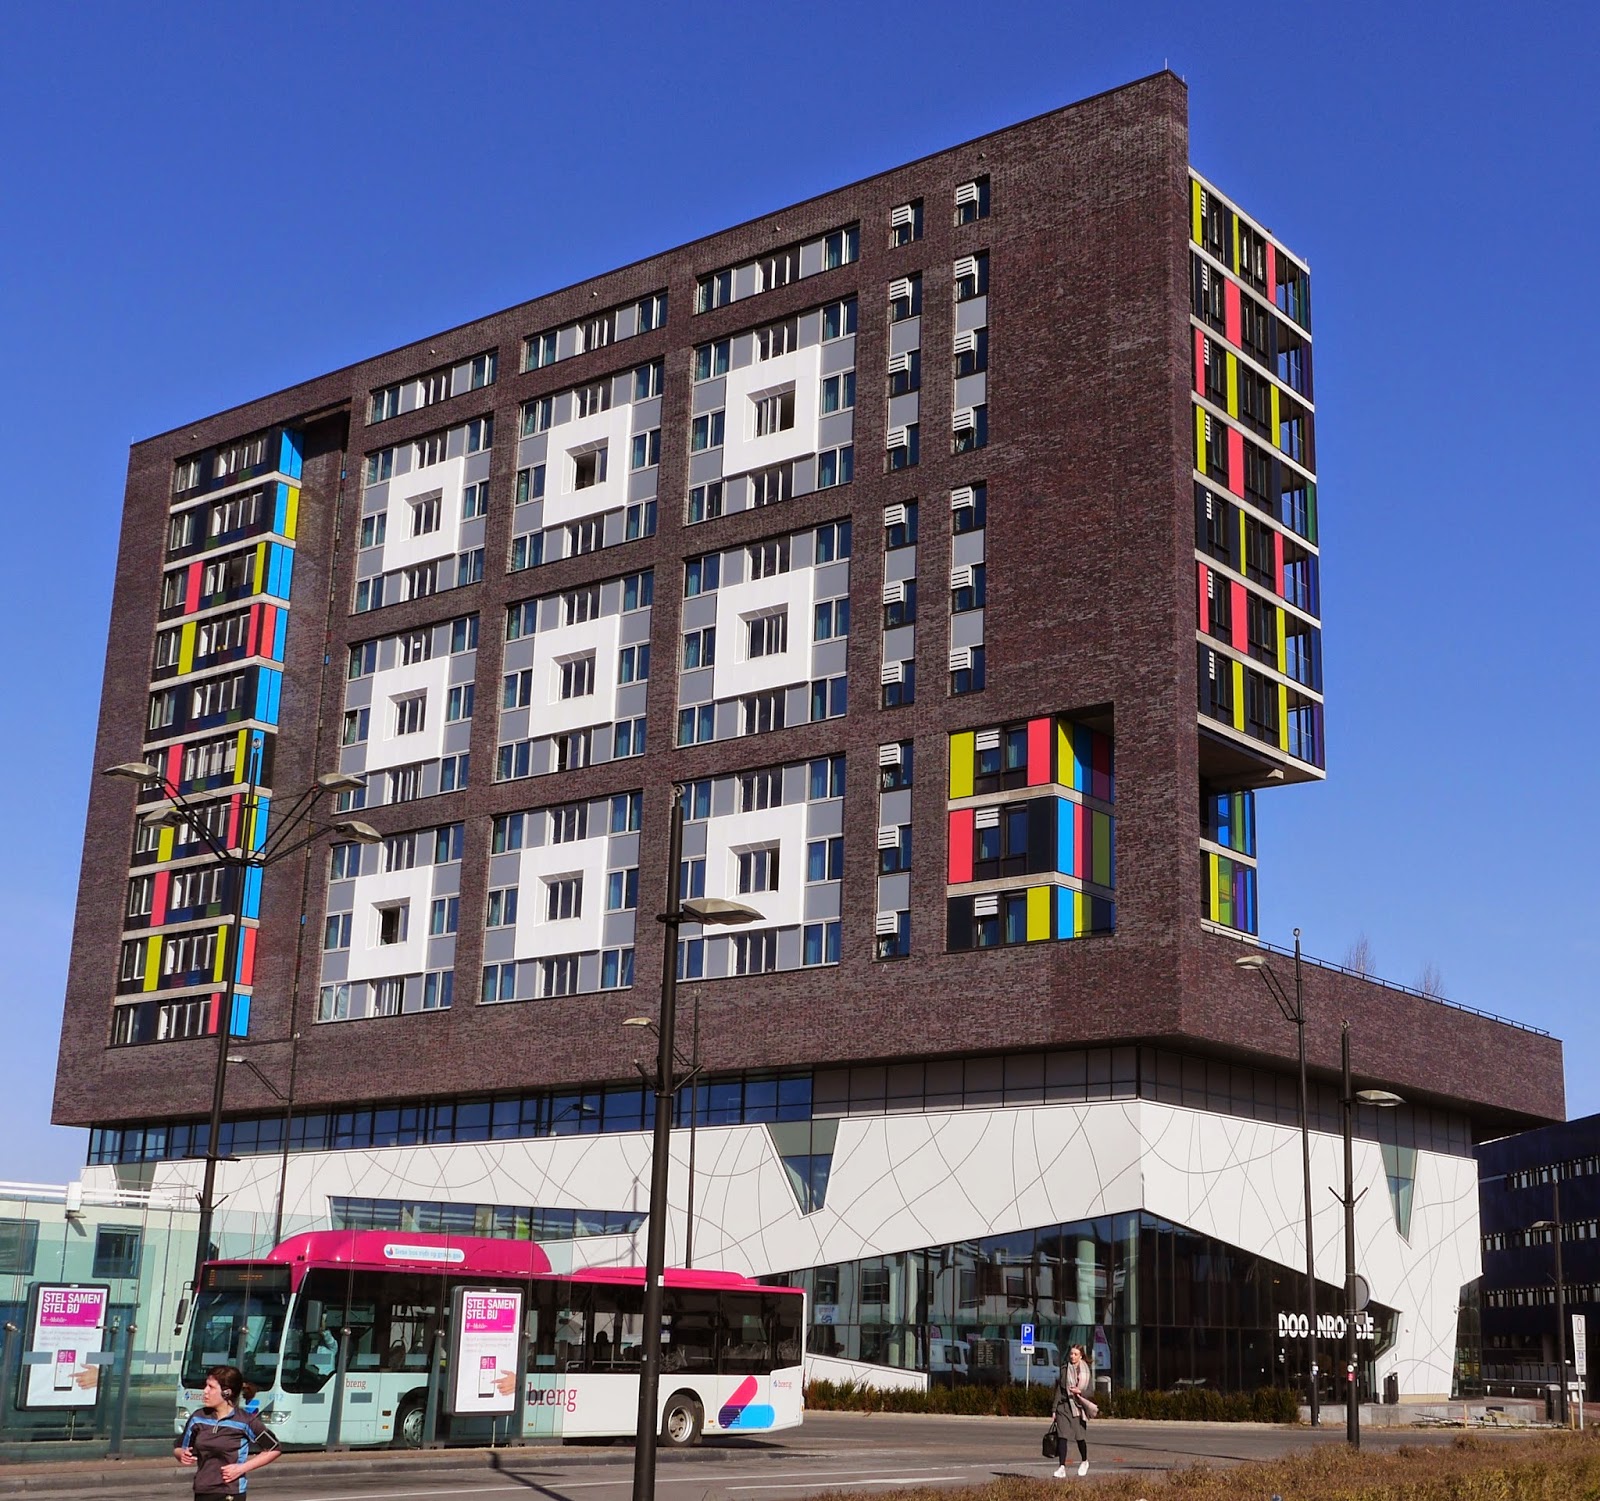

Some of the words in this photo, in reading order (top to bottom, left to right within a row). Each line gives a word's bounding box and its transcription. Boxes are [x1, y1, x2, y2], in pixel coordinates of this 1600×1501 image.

[44, 1292, 66, 1303] STEL
[67, 1293, 101, 1304] SAMEN
[42, 1303, 66, 1313] STEL
[467, 1299, 487, 1310] STEL
[487, 1300, 515, 1310] SAMEN
[466, 1310, 486, 1320] STEL
[1024, 1325, 1032, 1338] P
[345, 1378, 367, 1390] breng
[527, 1382, 578, 1412] breng
